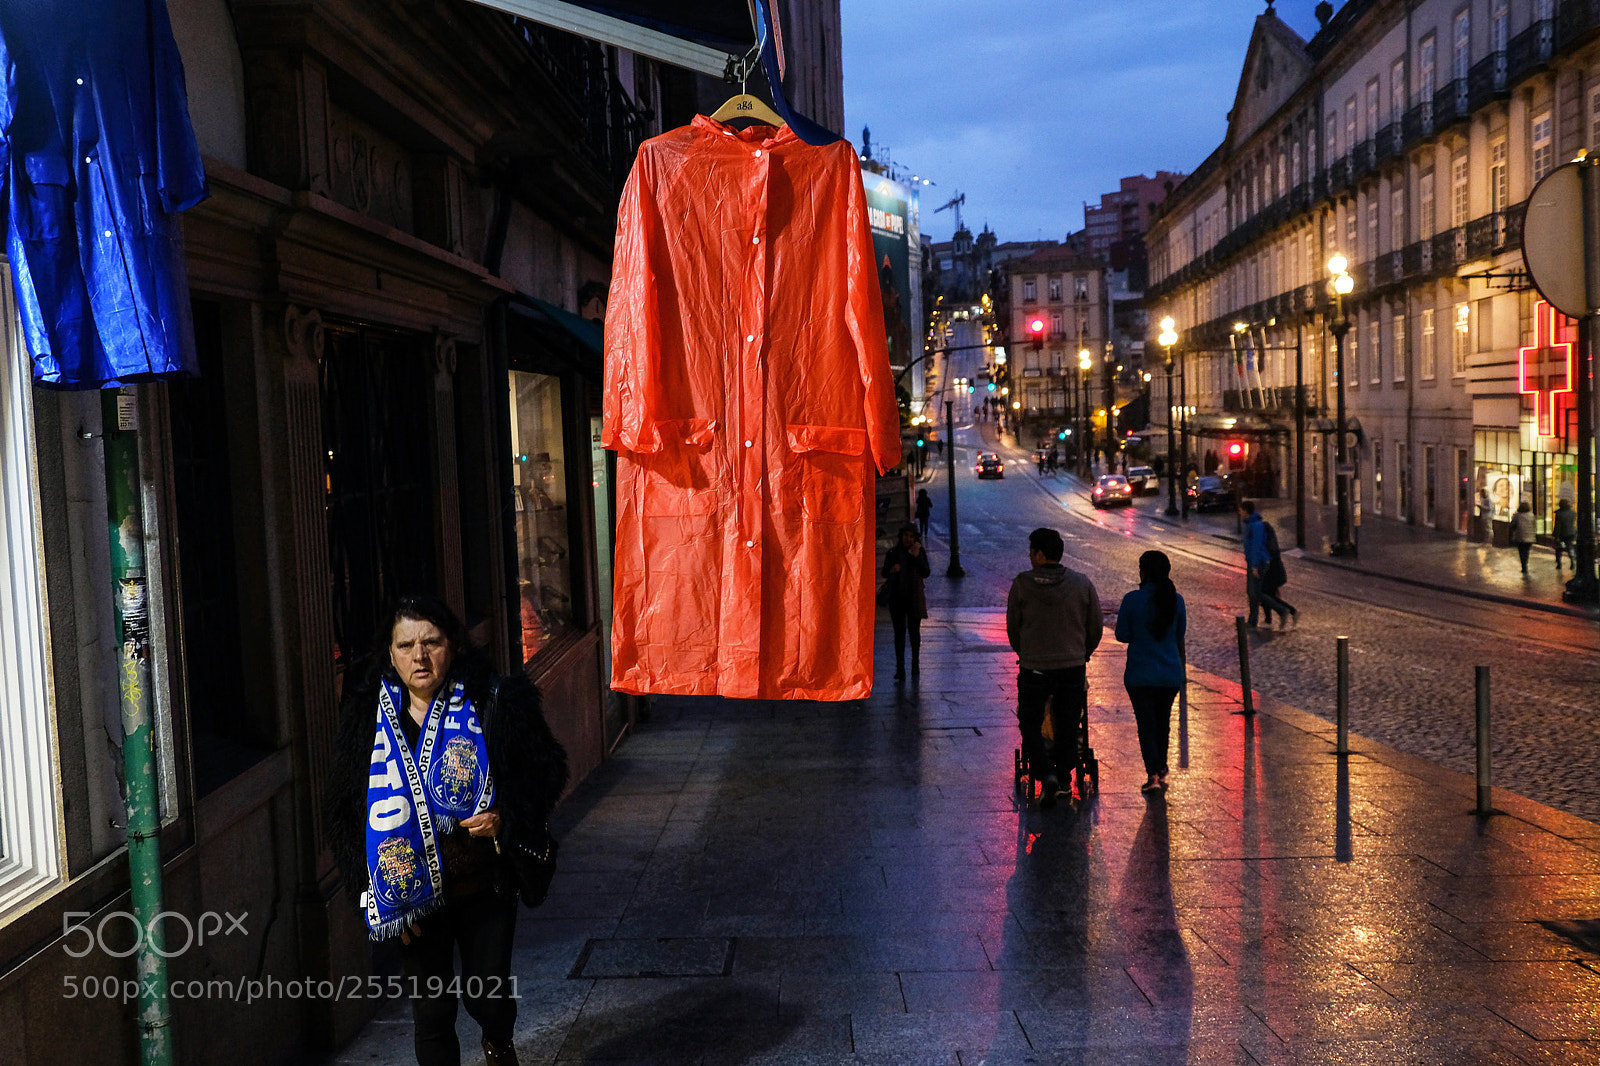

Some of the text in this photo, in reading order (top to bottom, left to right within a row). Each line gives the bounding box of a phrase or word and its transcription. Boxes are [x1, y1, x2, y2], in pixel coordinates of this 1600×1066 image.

[736, 101, 753, 111] agá
[419, 740, 434, 780] ORTO
[404, 757, 421, 797] PORTO
[419, 812, 432, 840] UMA
